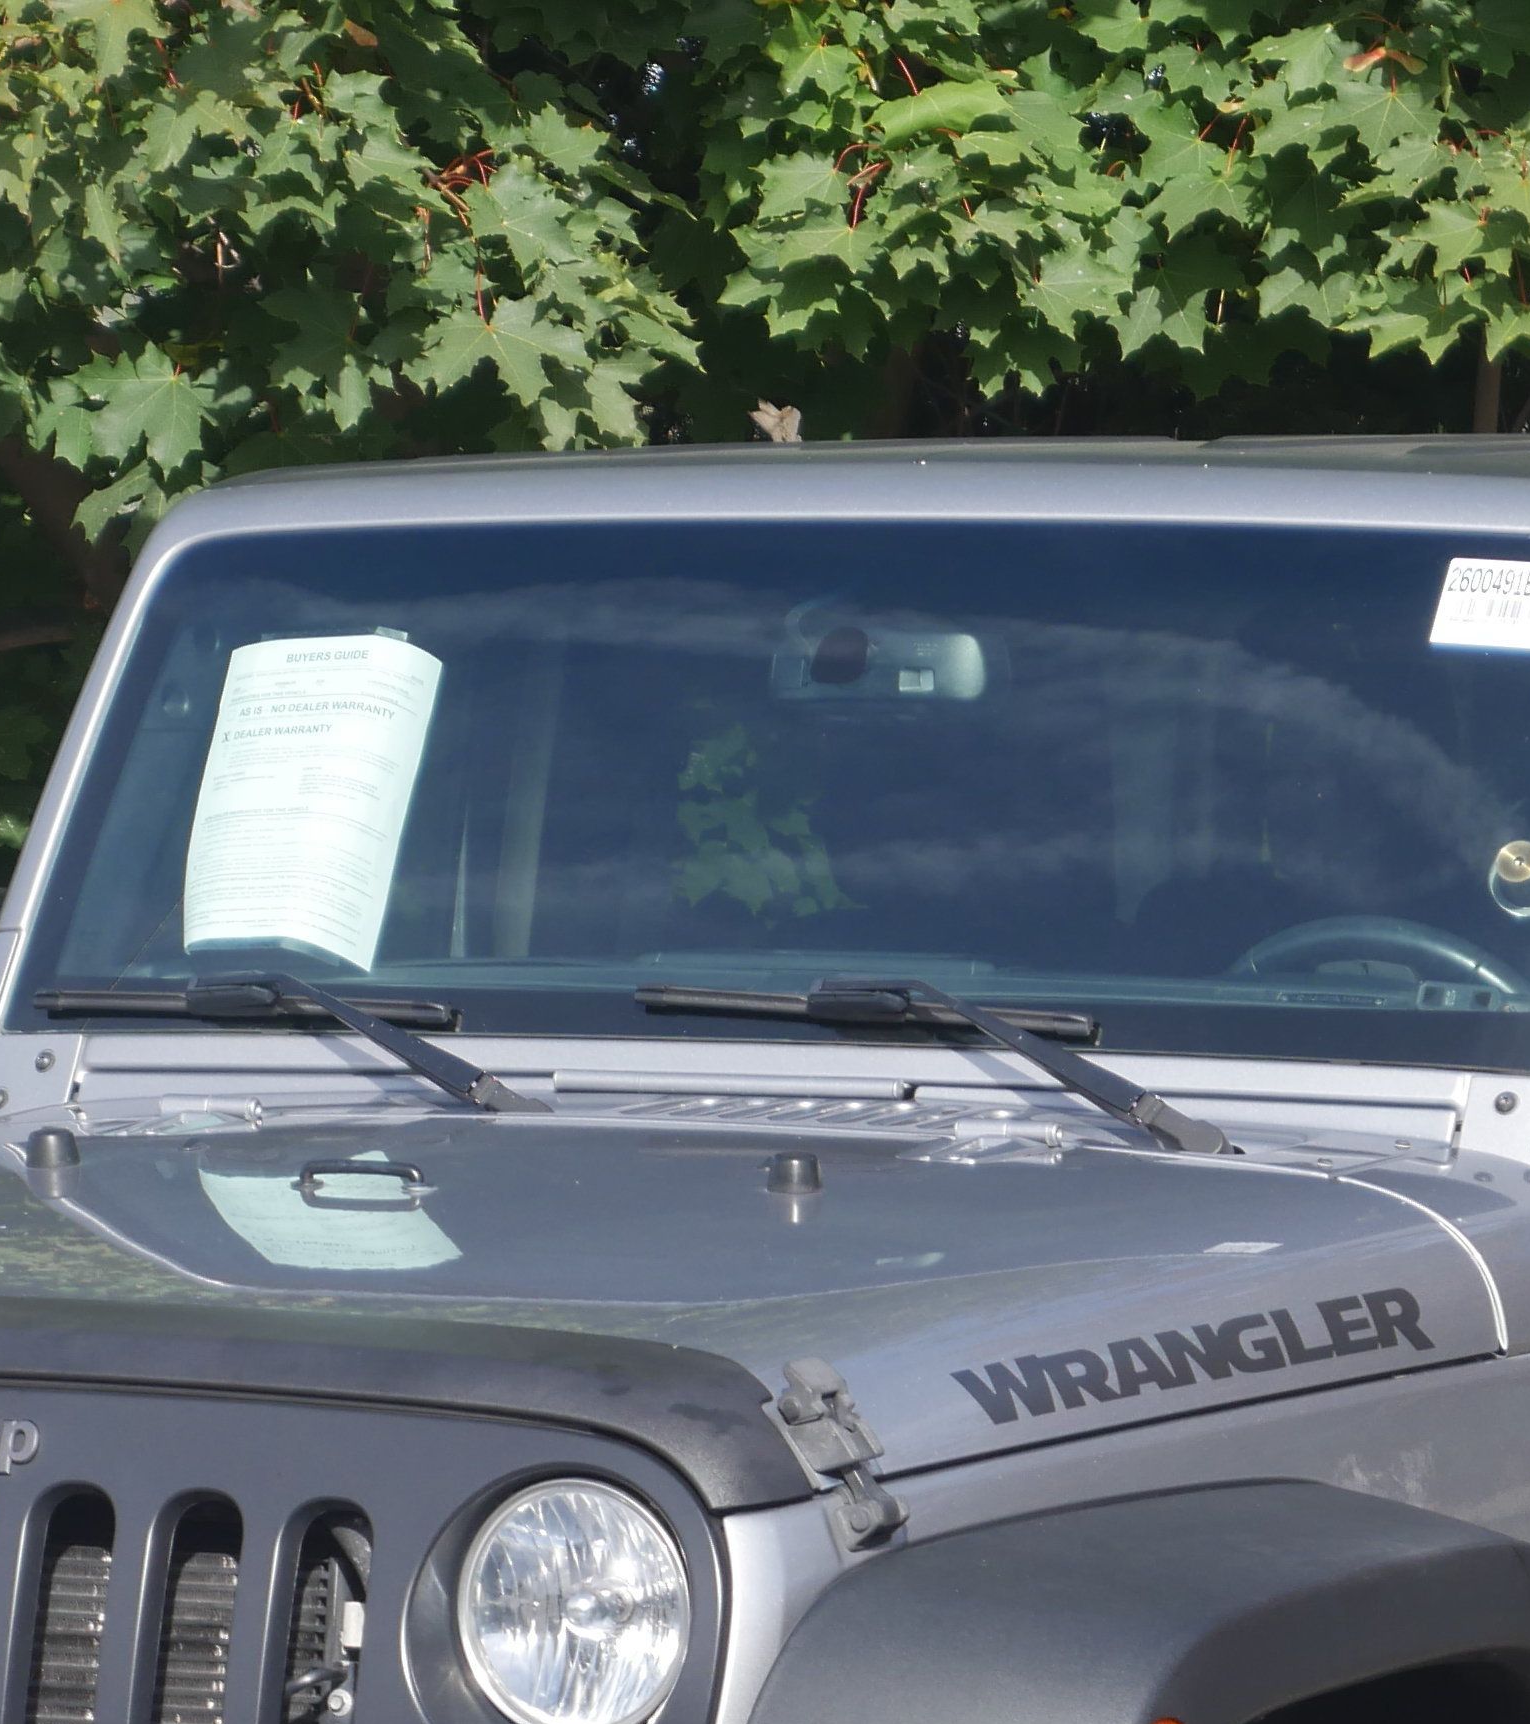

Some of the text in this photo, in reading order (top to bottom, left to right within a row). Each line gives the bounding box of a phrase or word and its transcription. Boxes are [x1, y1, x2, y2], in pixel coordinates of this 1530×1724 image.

[286, 650, 369, 663] BUYERS GUIDE
[271, 704, 286, 714] NO
[288, 701, 329, 713] DEALER
[332, 700, 395, 720] WARRANTY
[234, 727, 271, 740] DEALER
[274, 724, 332, 736] WARRANTY
[950, 1287, 1435, 1426] WRANGLER
